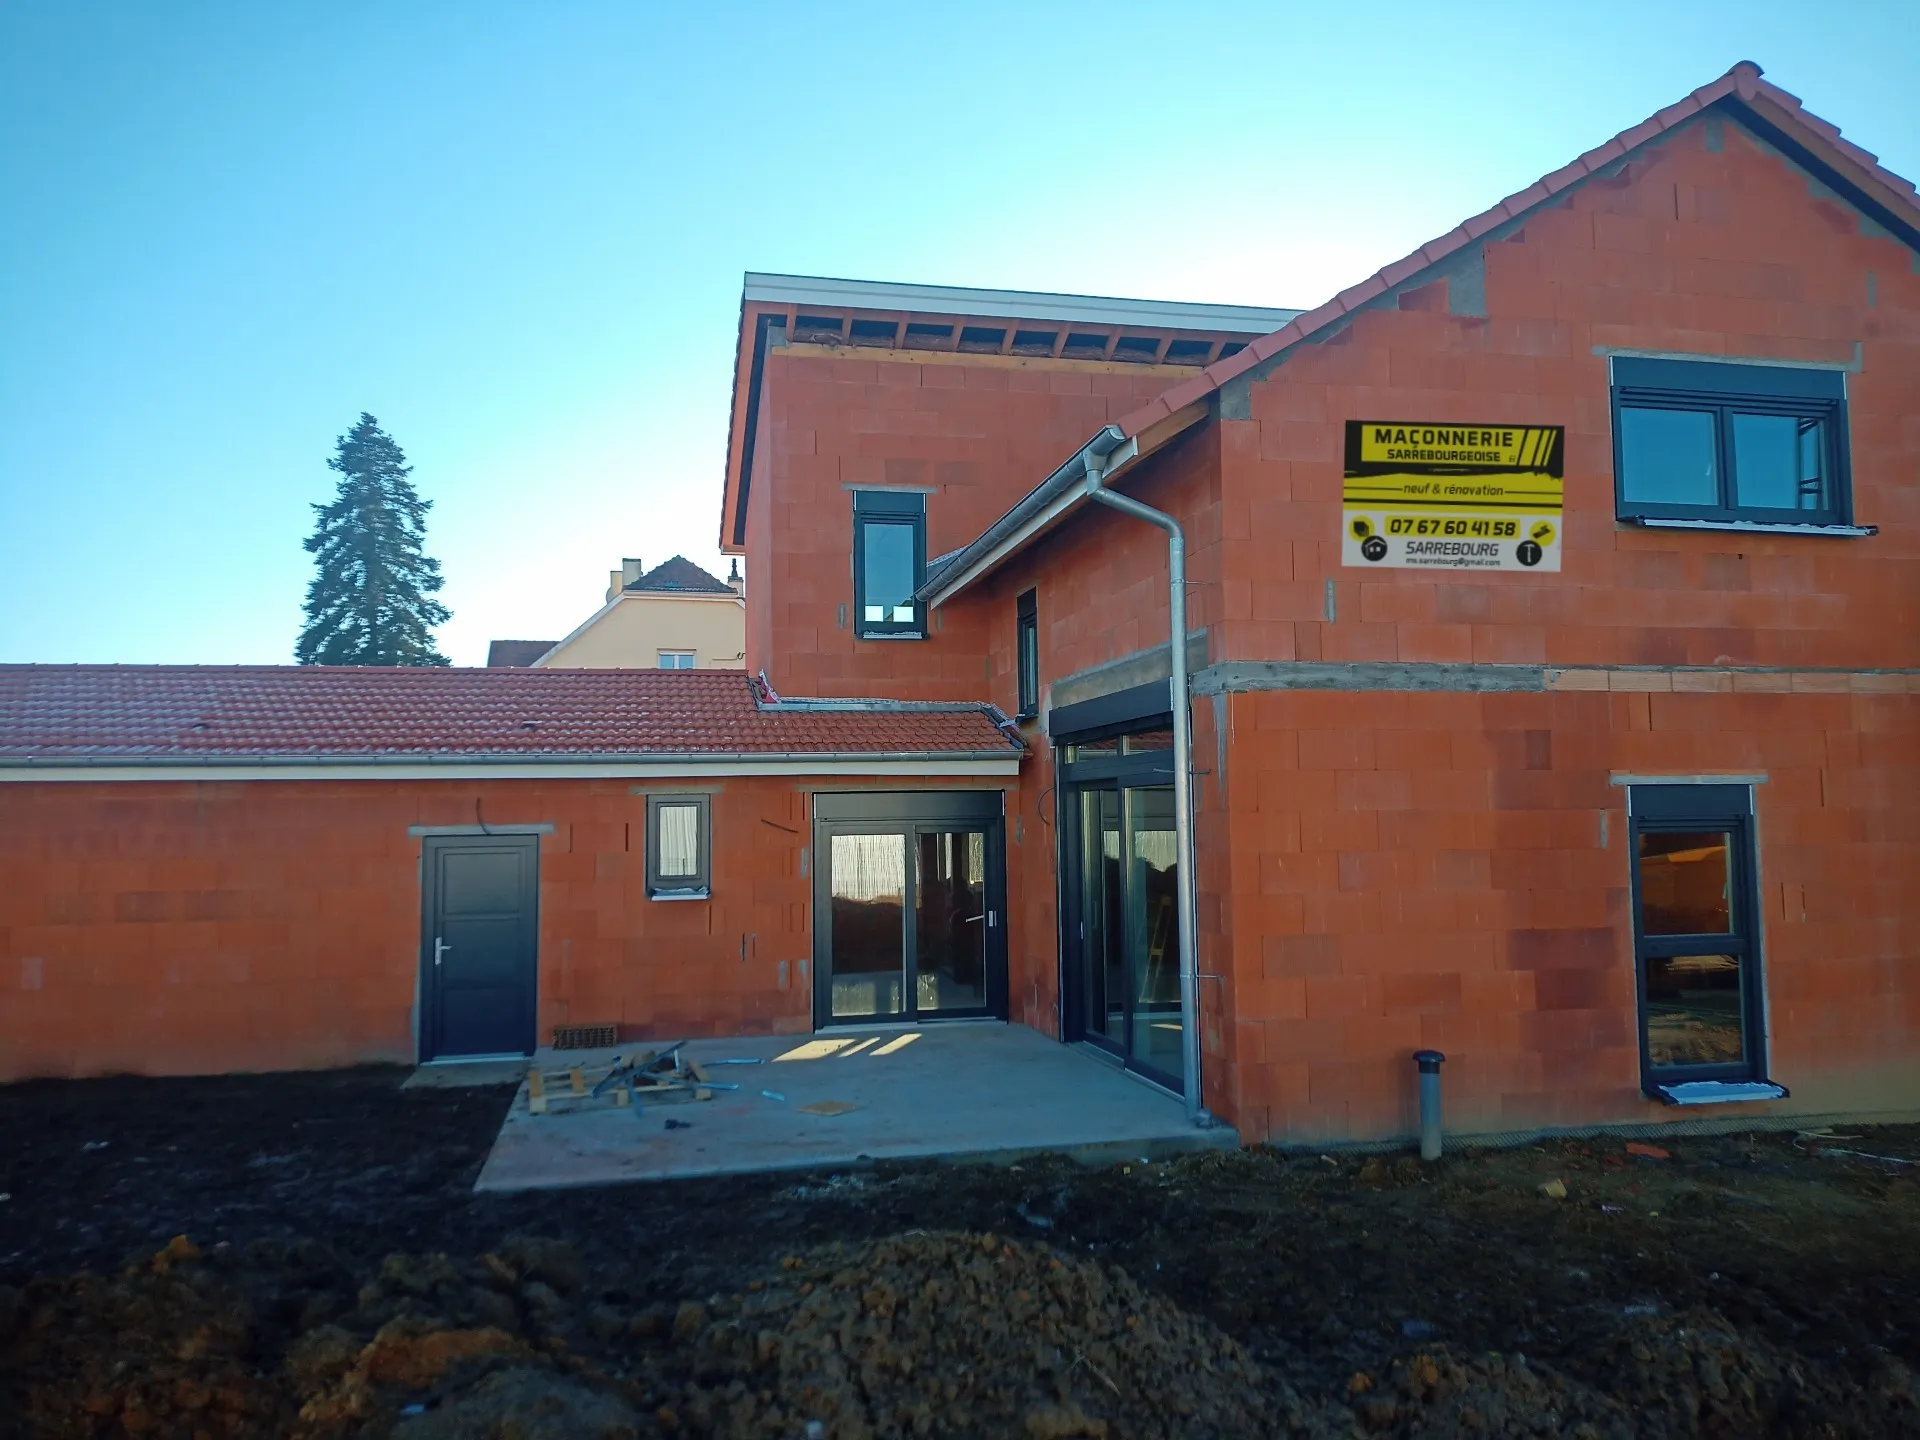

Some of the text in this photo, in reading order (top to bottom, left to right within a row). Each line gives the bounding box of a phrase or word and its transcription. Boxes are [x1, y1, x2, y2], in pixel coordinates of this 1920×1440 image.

[1375, 428, 1513, 448] MAÇONNERIE
[1387, 449, 1501, 462] SARREBOURGEOISE
[1403, 483, 1504, 496] neuf & rénovation
[1390, 519, 1516, 536] 07 67 60 41 58
[1405, 541, 1499, 556] SARREBOURG
